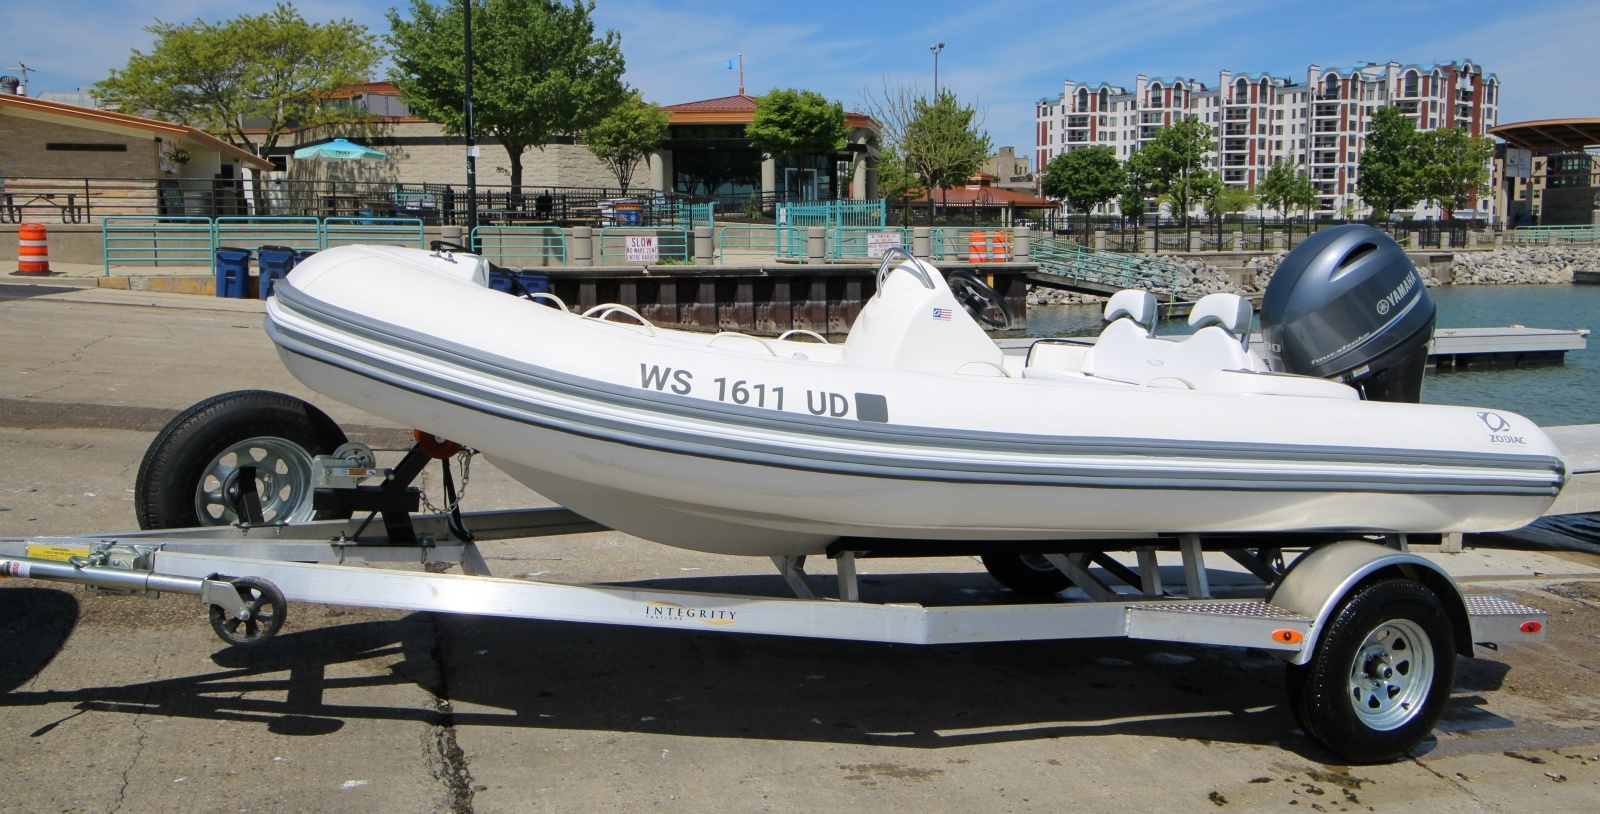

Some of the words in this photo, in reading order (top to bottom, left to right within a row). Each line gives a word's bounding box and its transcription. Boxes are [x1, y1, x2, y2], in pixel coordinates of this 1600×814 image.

[632, 237, 652, 247] SLOW
[1386, 270, 1417, 307] YAMAHA
[640, 363, 693, 395] WS
[714, 377, 784, 411] 1611
[806, 389, 849, 417] UD
[1489, 434, 1527, 444] ZODIAC
[646, 606, 737, 620] INTEGRITY
